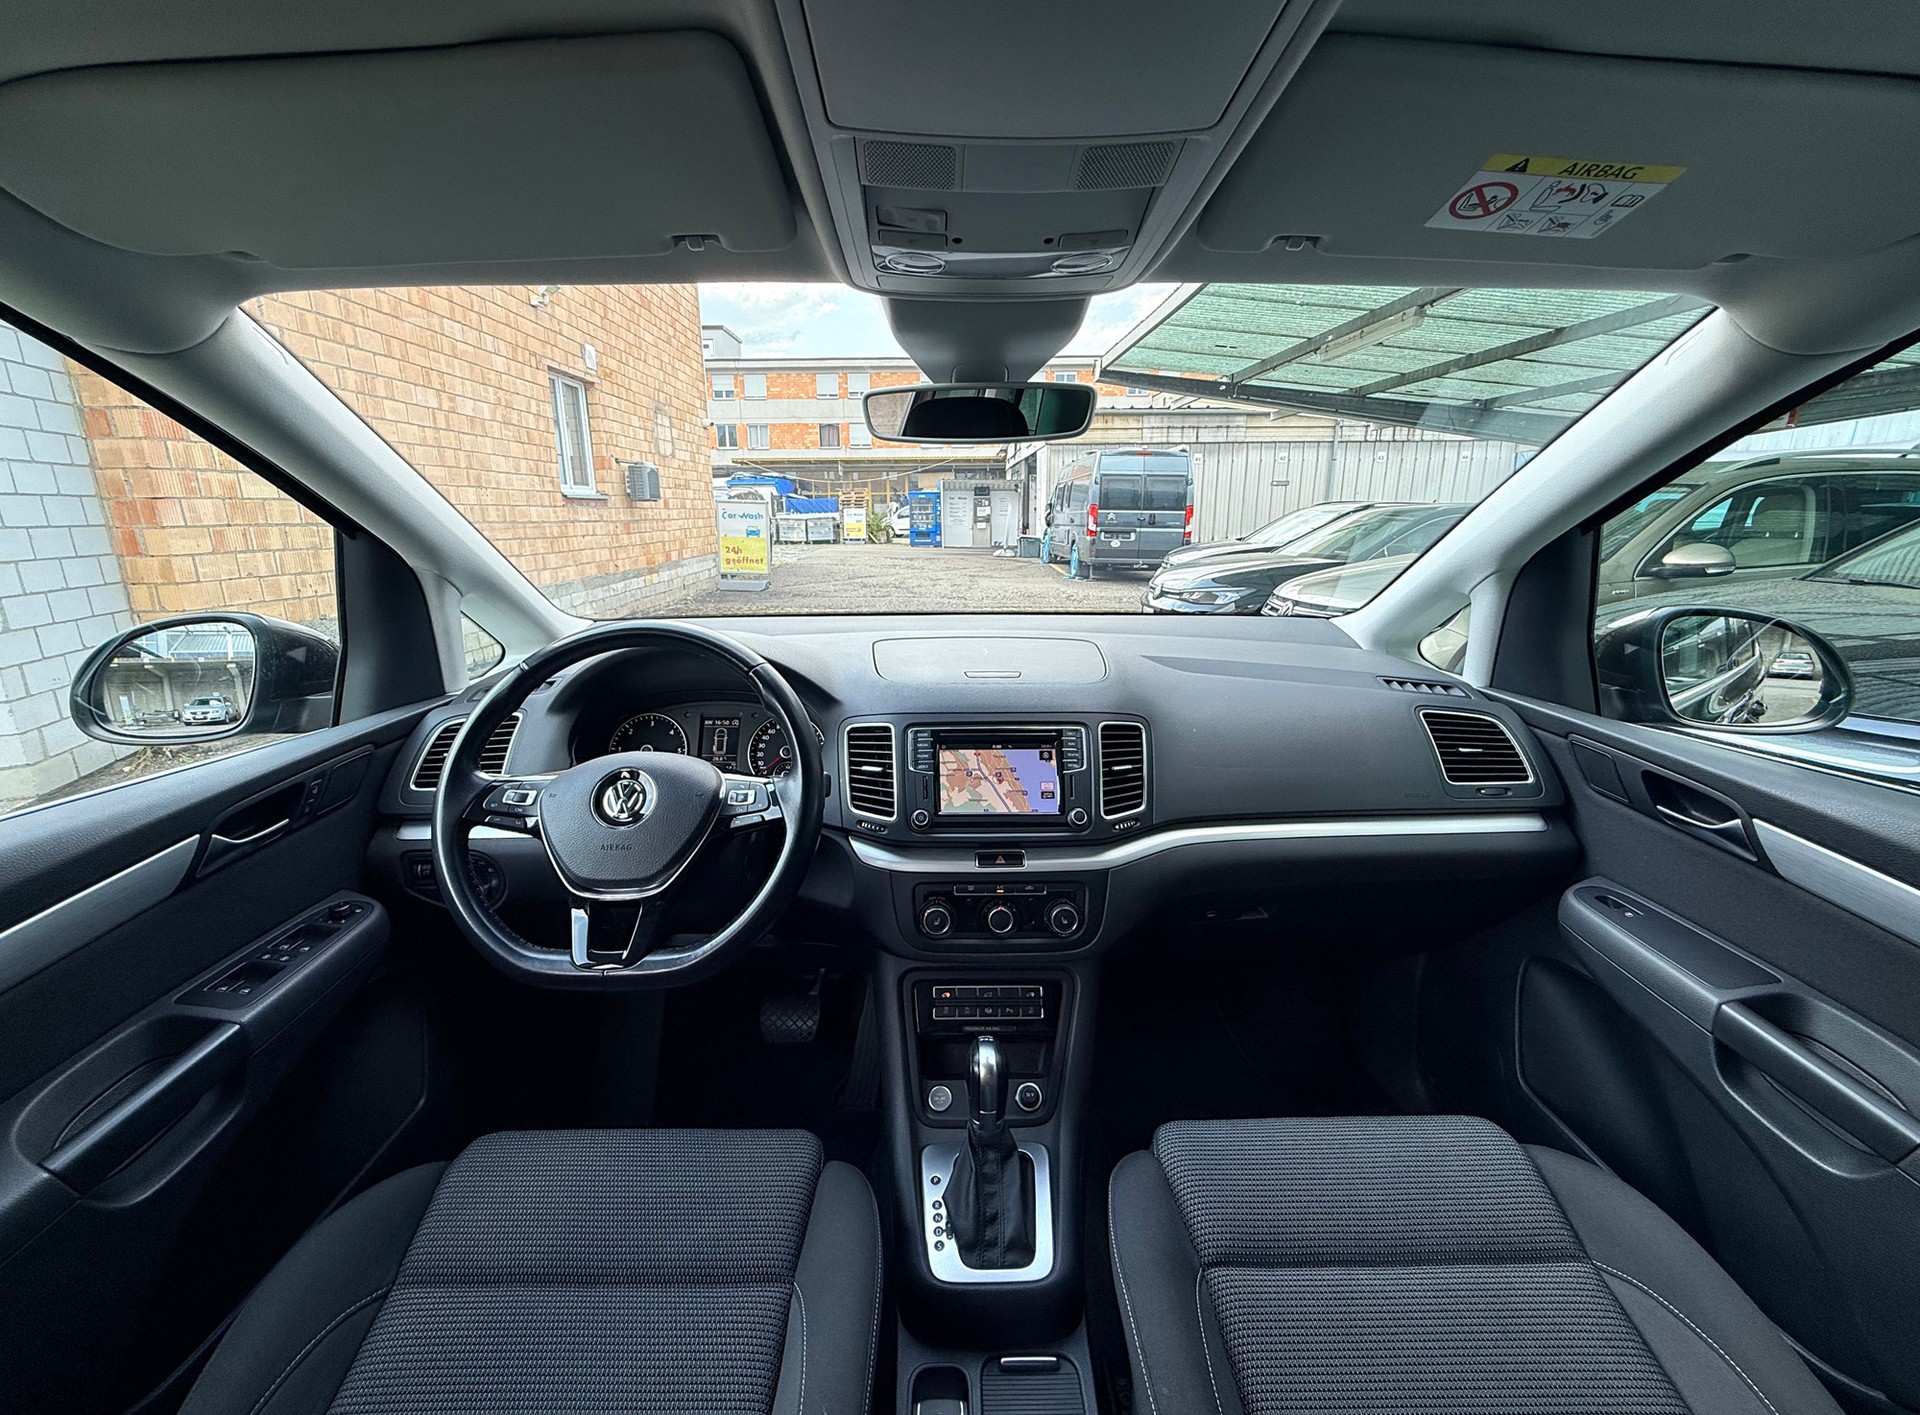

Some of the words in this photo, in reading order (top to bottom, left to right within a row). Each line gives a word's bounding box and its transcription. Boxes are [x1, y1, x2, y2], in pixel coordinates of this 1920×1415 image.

[1557, 161, 1644, 180] AIRBAG
[721, 511, 737, 520] Car
[725, 545, 743, 555] 24h
[725, 556, 764, 565] geöffnet
[599, 843, 633, 851] AIRBAG
